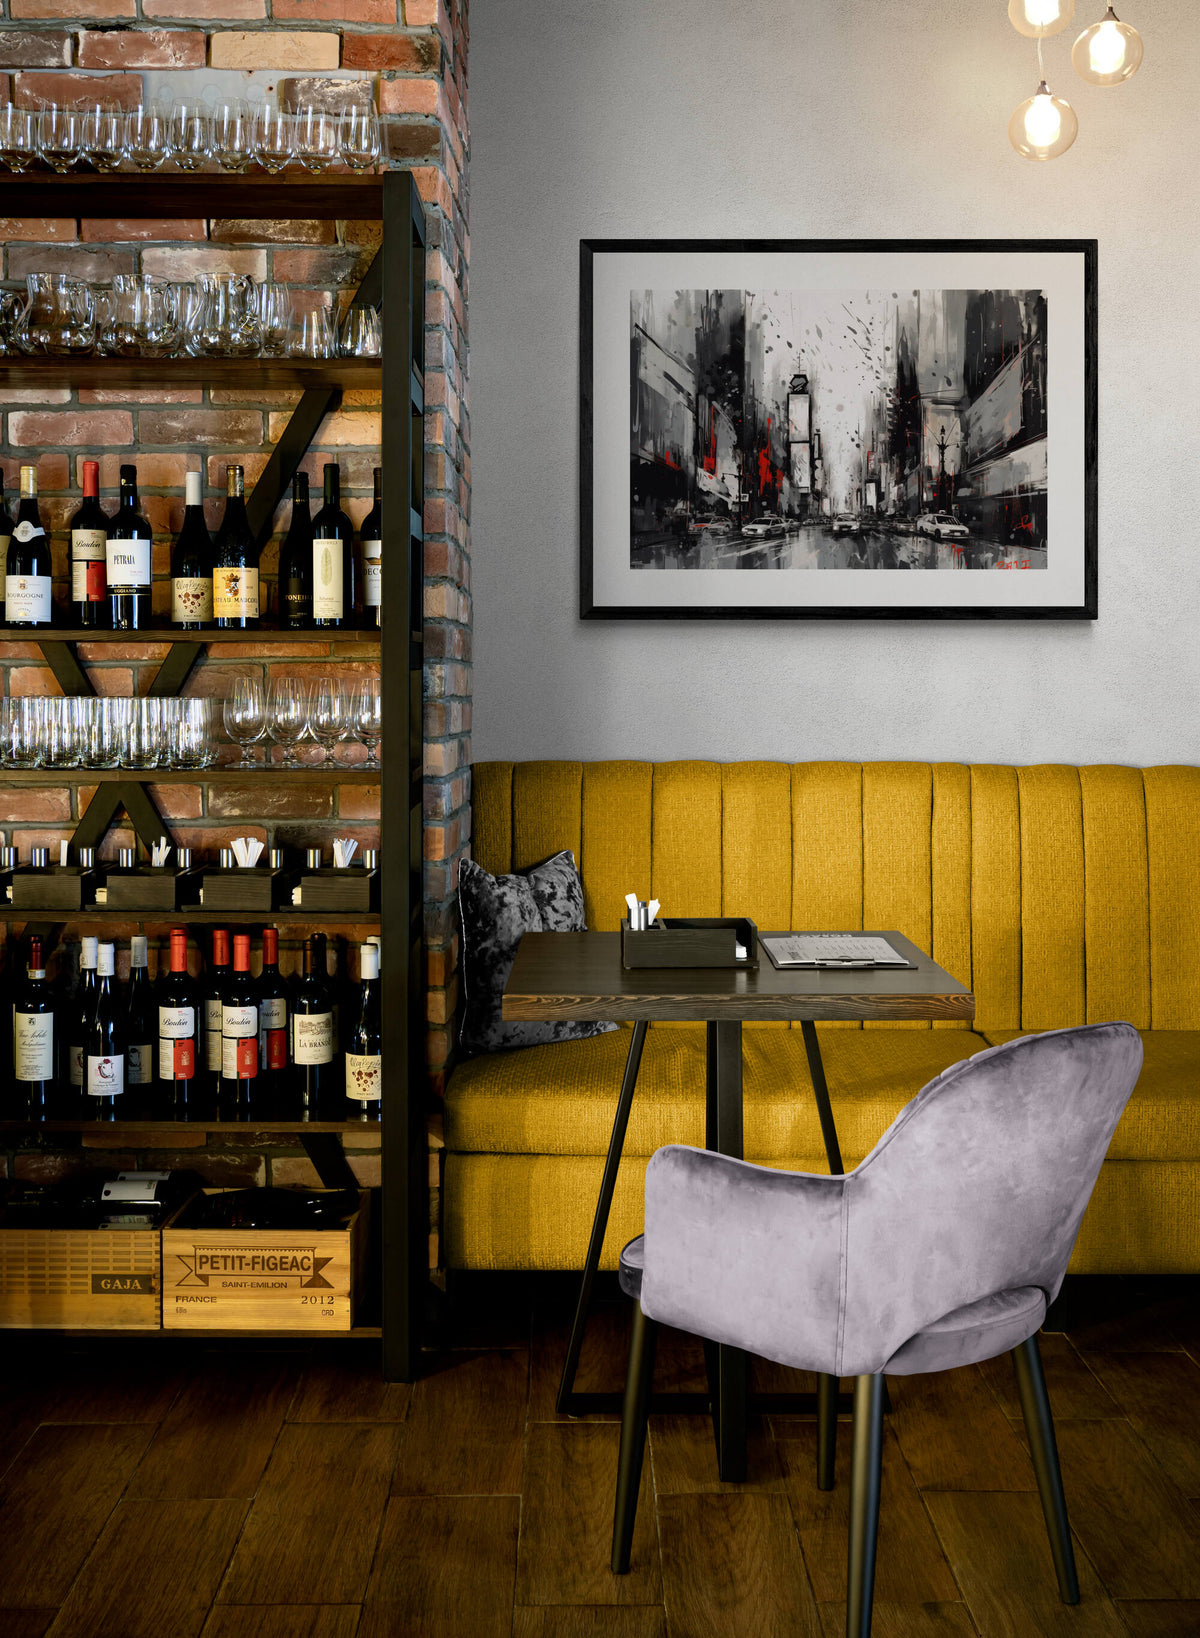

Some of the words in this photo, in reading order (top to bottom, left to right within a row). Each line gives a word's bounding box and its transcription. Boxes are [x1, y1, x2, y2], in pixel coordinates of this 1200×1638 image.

[113, 554, 136, 565] PETRAIA
[199, 1255, 311, 1271] PETIT-FIGEAC
[100, 1279, 142, 1290] GAJA
[221, 1281, 288, 1289] SAINT-EMILION
[175, 1295, 217, 1303] FRANCE
[301, 1295, 334, 1305] 2012
